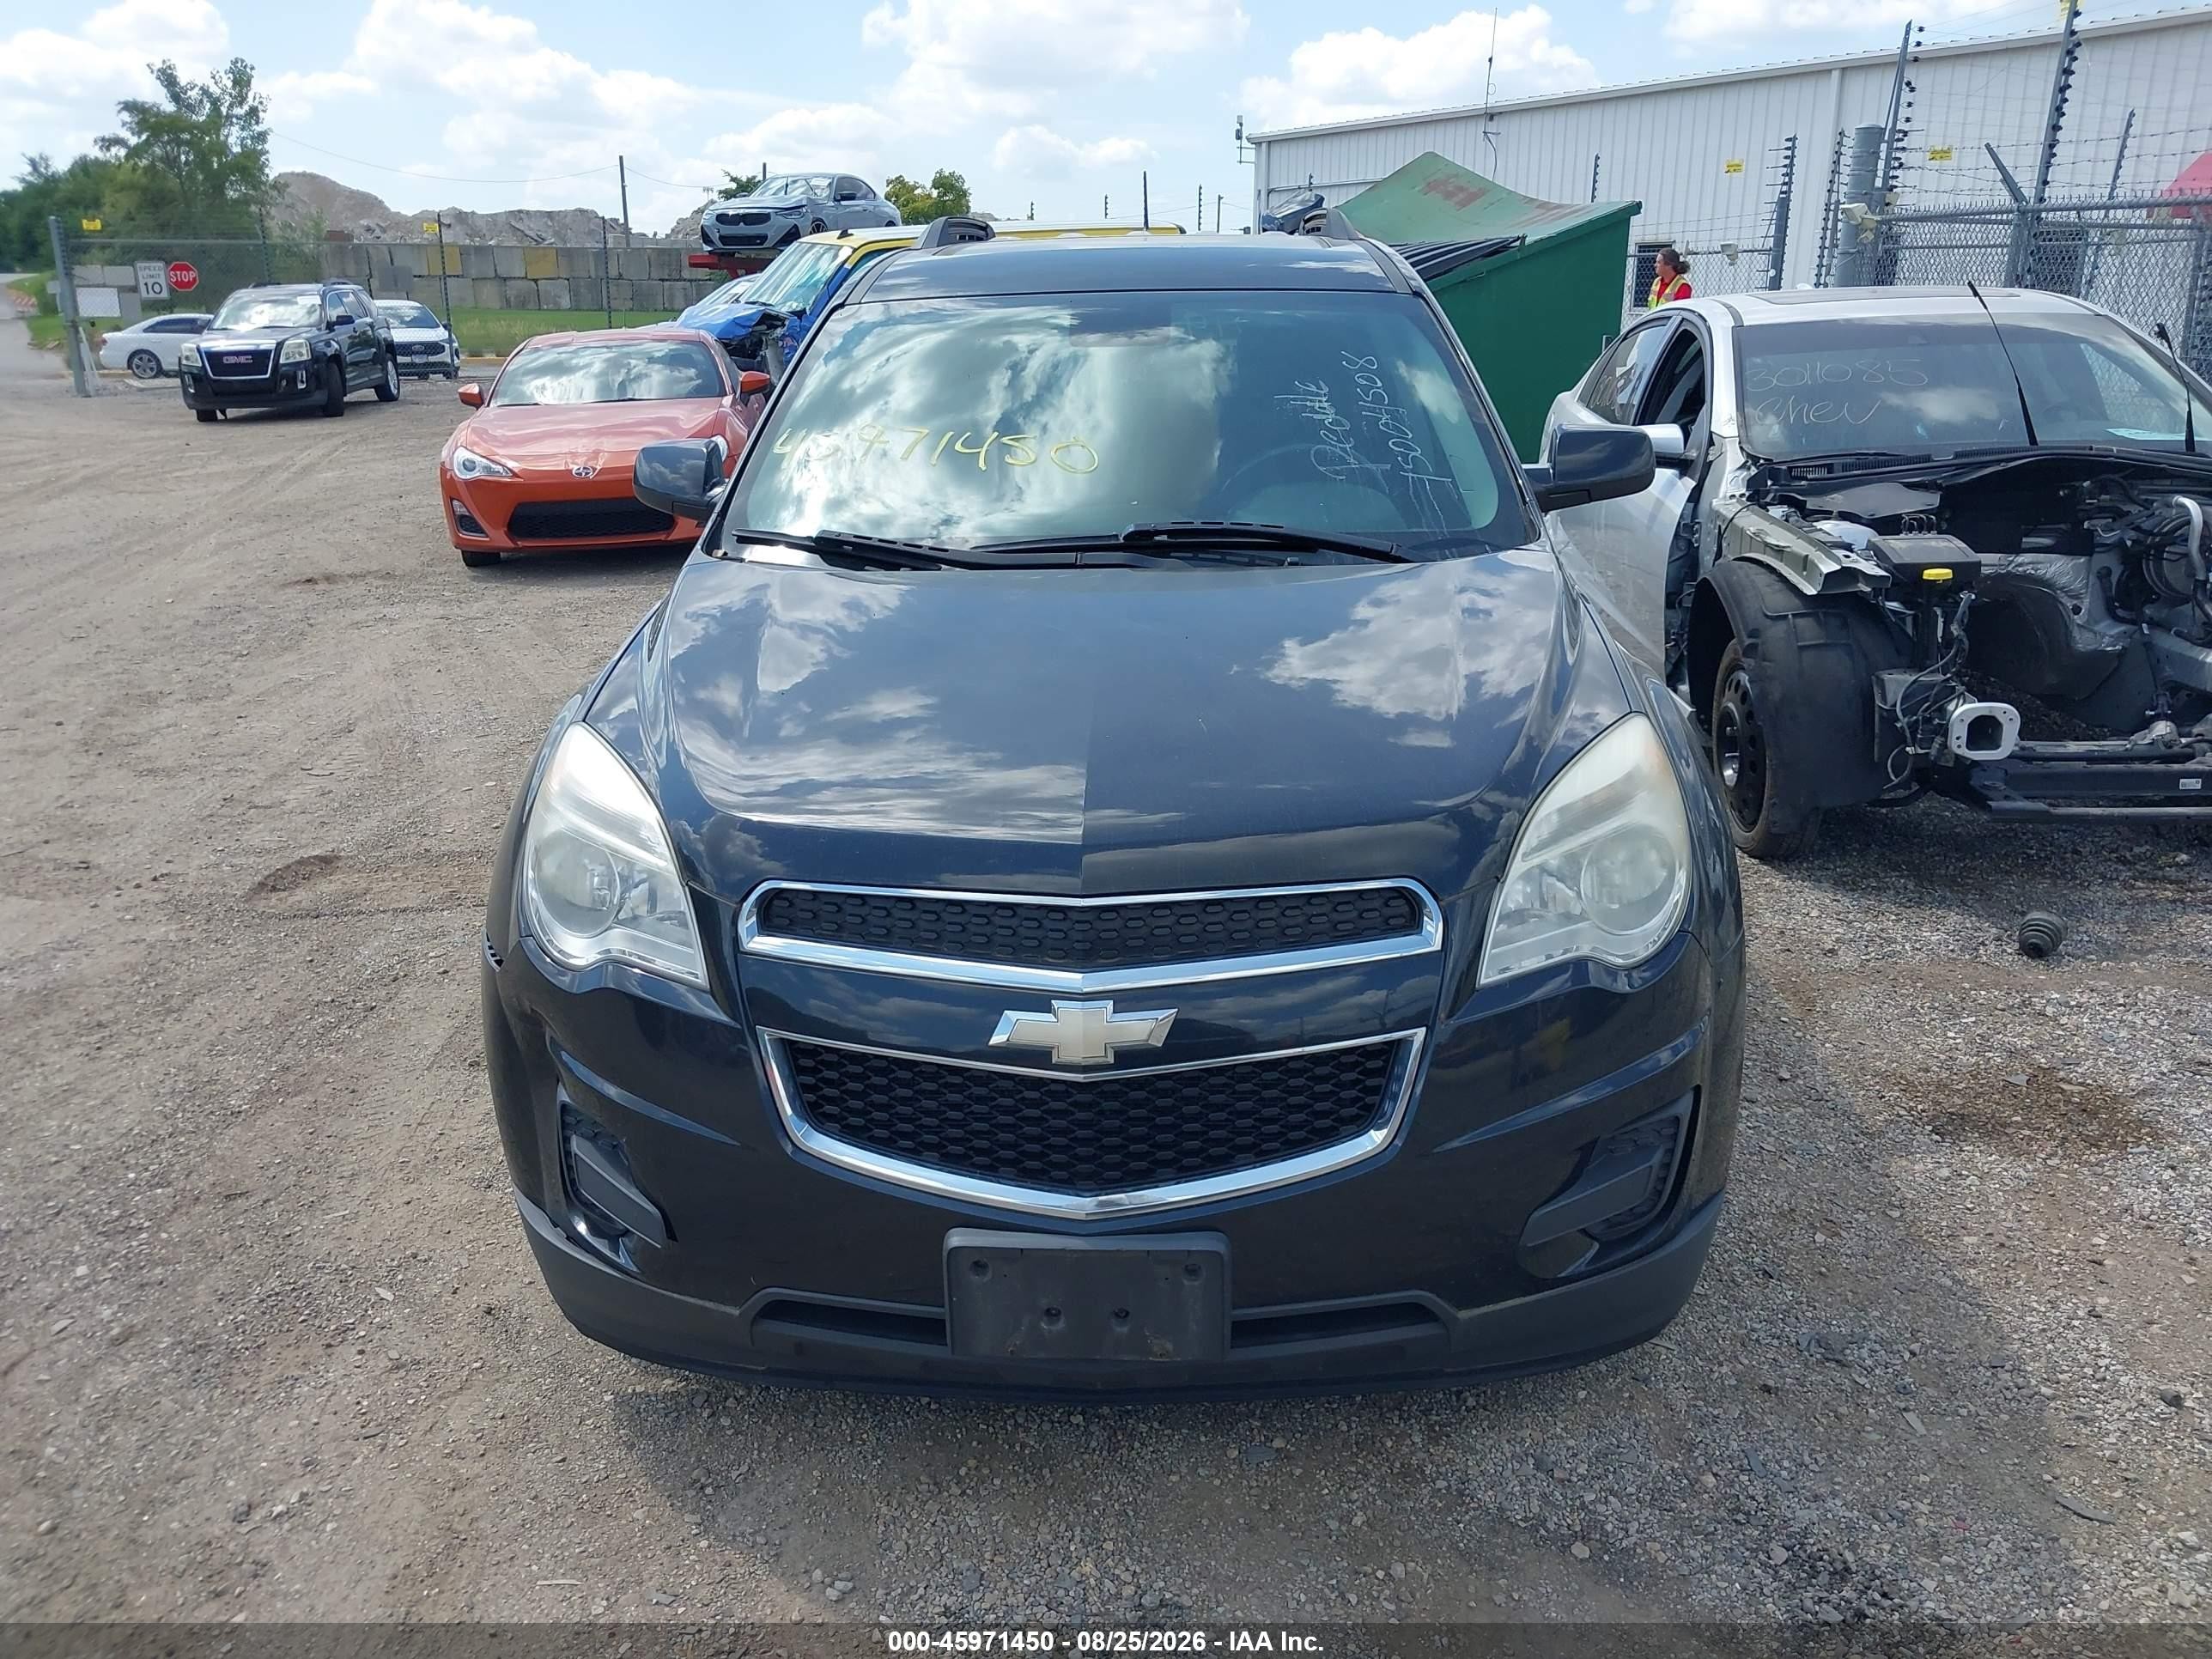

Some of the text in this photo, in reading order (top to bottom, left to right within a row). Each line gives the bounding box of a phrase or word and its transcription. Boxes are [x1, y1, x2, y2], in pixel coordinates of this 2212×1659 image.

[170, 270, 196, 283] STOP
[144, 282, 163, 295] 10
[223, 355, 253, 363] GMC
[1746, 358, 1929, 392] 3011085
[774, 422, 1098, 474] 45971450
